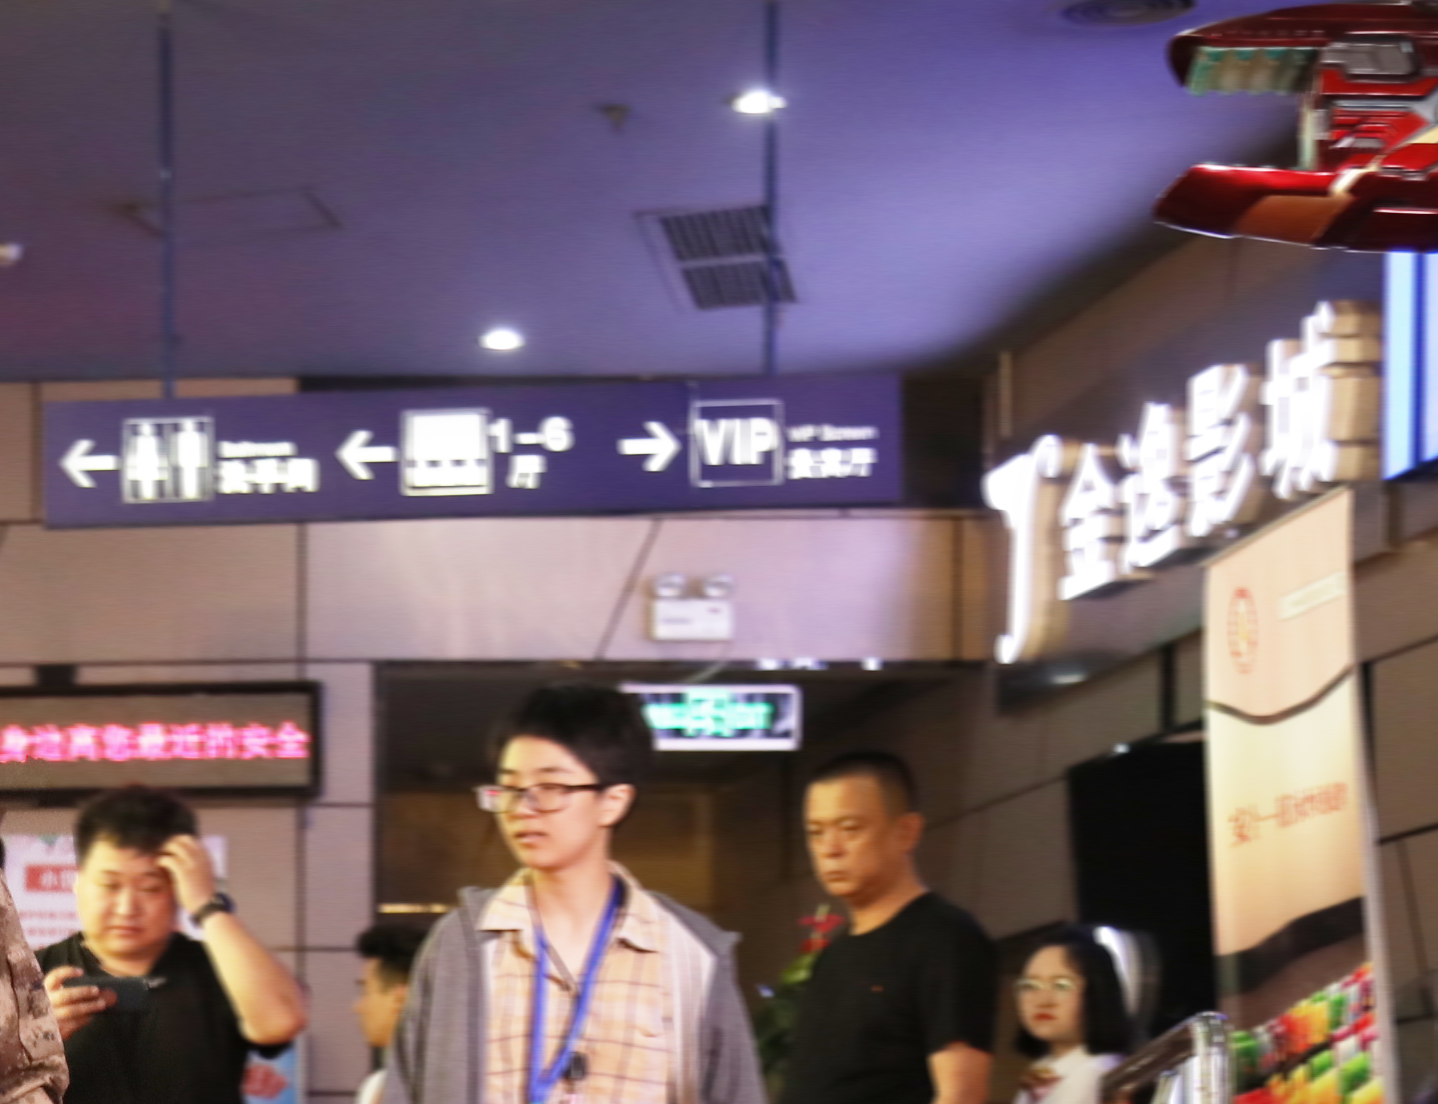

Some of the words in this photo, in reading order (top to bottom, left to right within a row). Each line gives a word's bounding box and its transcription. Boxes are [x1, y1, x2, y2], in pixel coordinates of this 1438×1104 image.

[693, 417, 781, 466] VIP
[1058, 300, 1339, 602] 金逸影城
